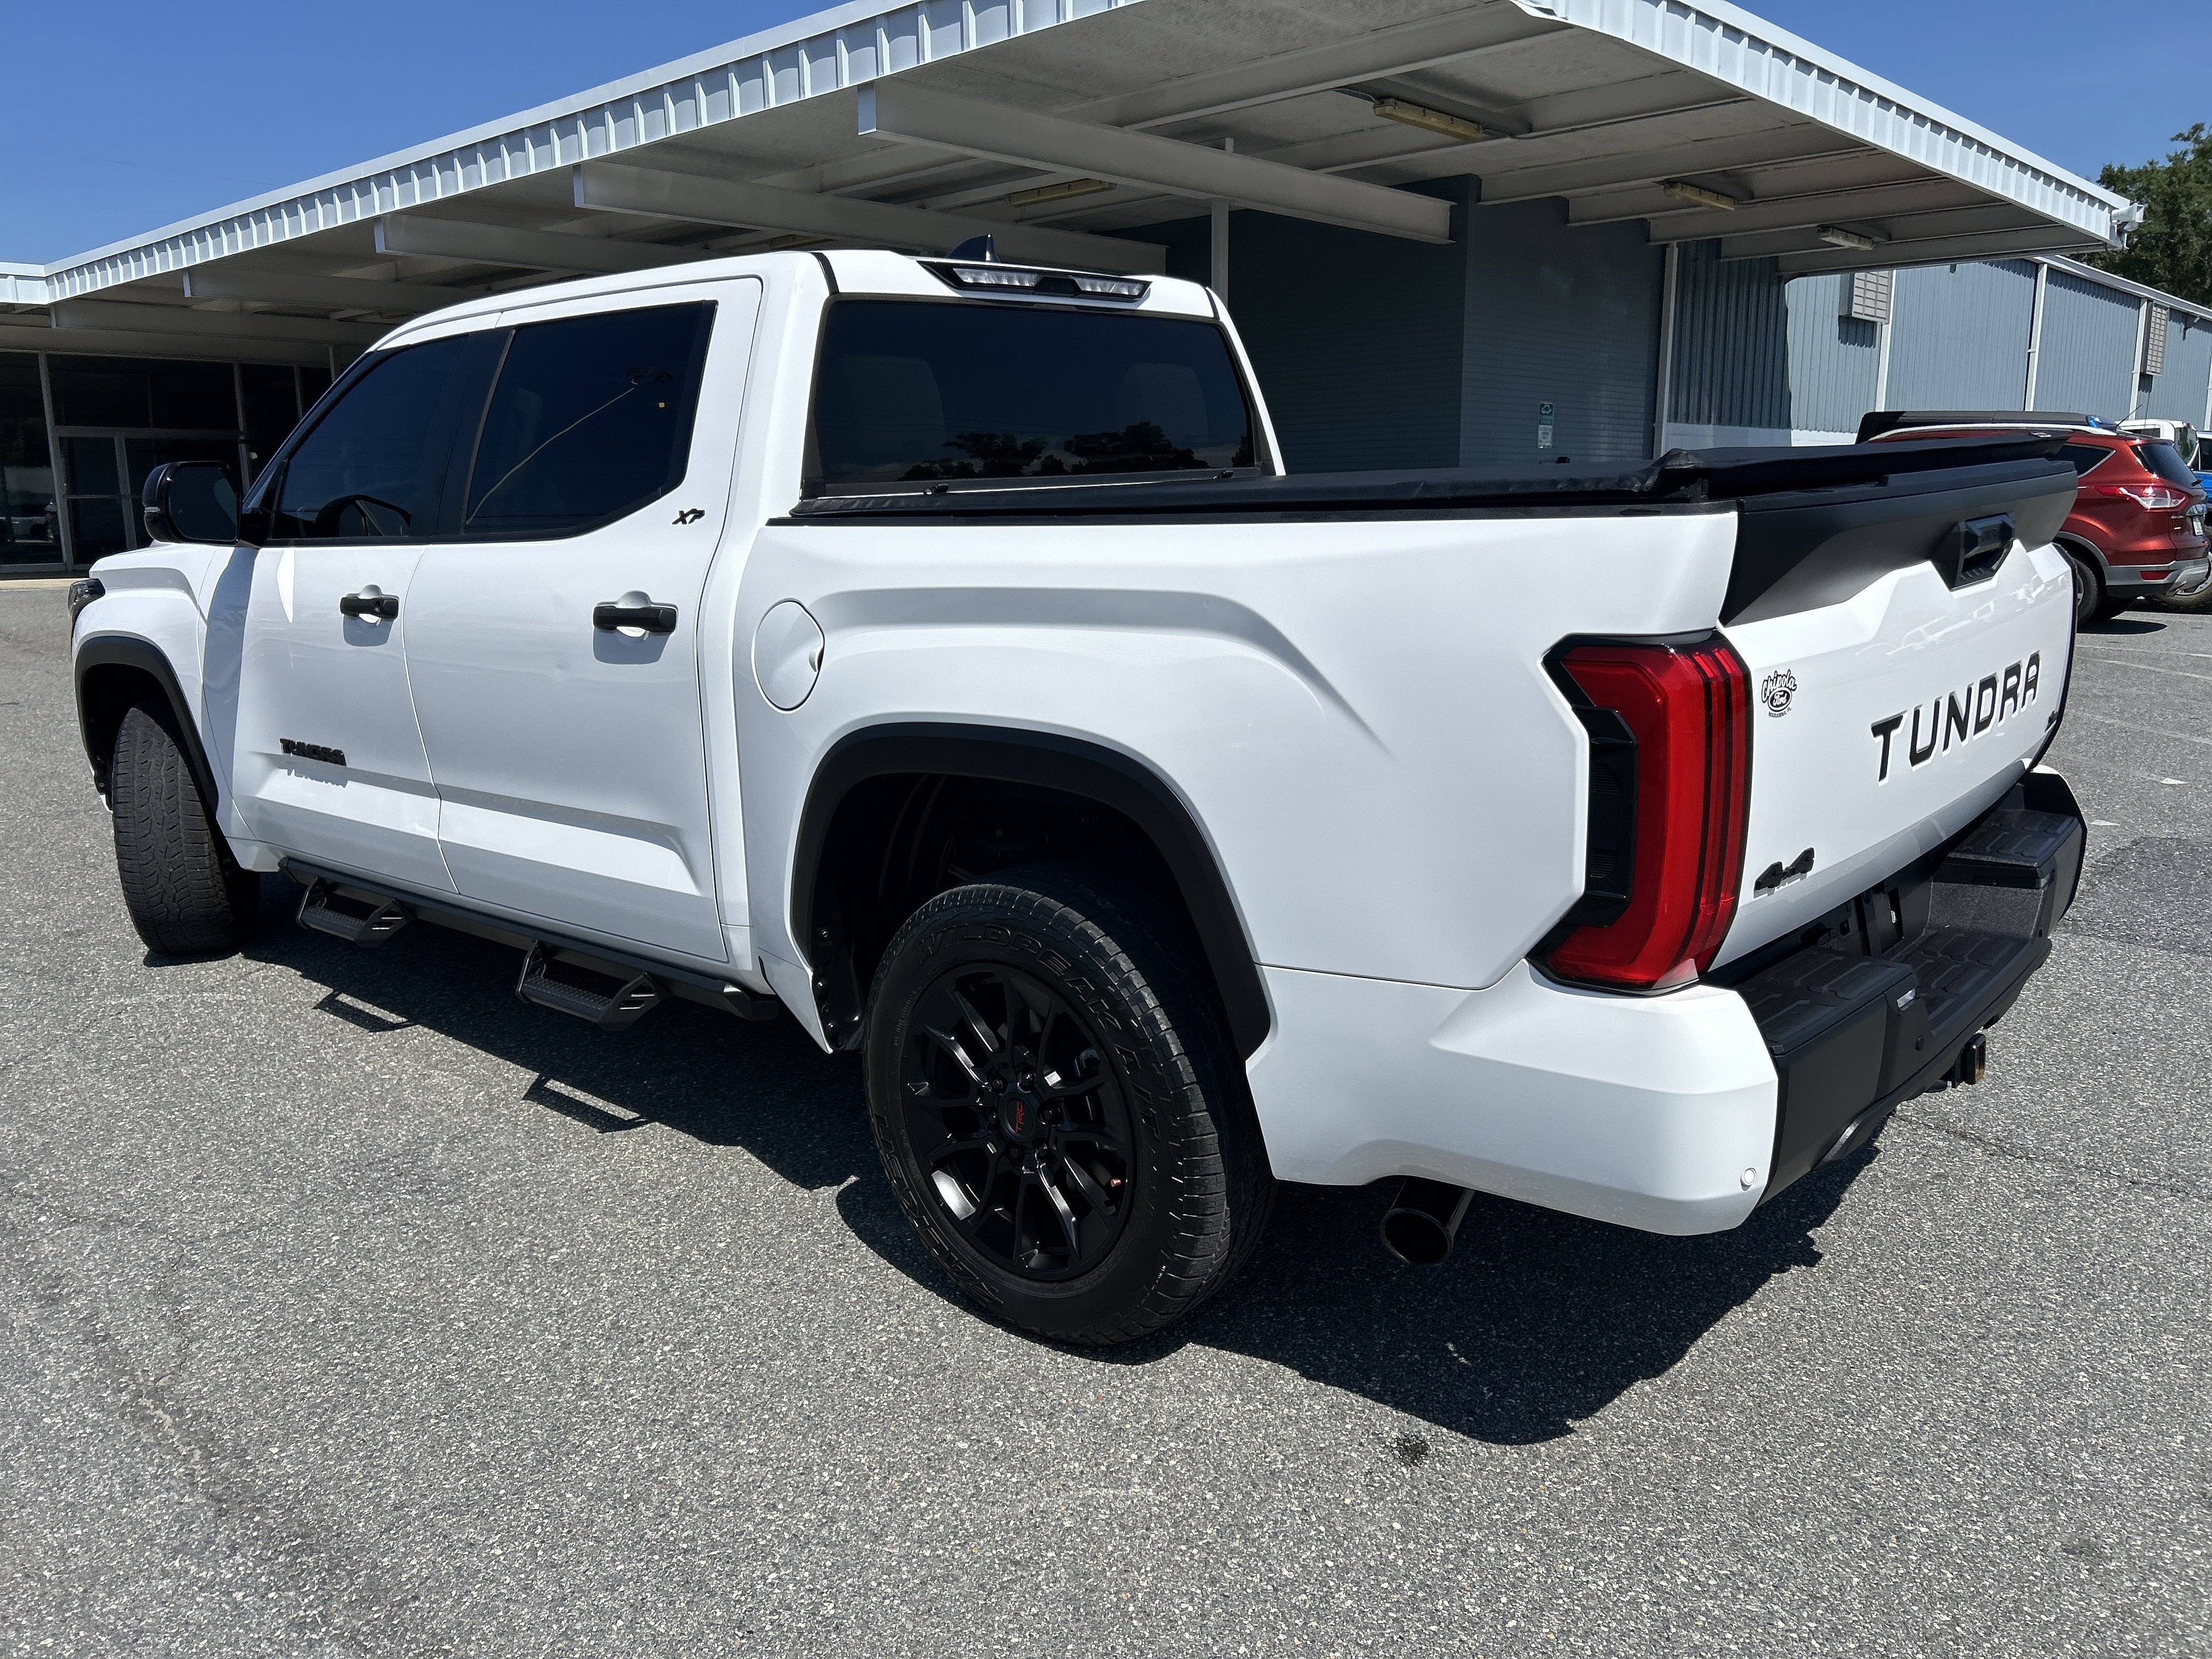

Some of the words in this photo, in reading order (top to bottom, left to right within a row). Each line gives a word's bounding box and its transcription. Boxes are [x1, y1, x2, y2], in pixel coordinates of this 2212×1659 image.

[1761, 669, 1797, 703] Chipola
[1871, 650, 2041, 782] TUNDRA
[279, 738, 347, 766] TUNDRA
[916, 923, 1122, 1031] WILDPEAK
[1015, 1099, 1025, 1133] TRD
